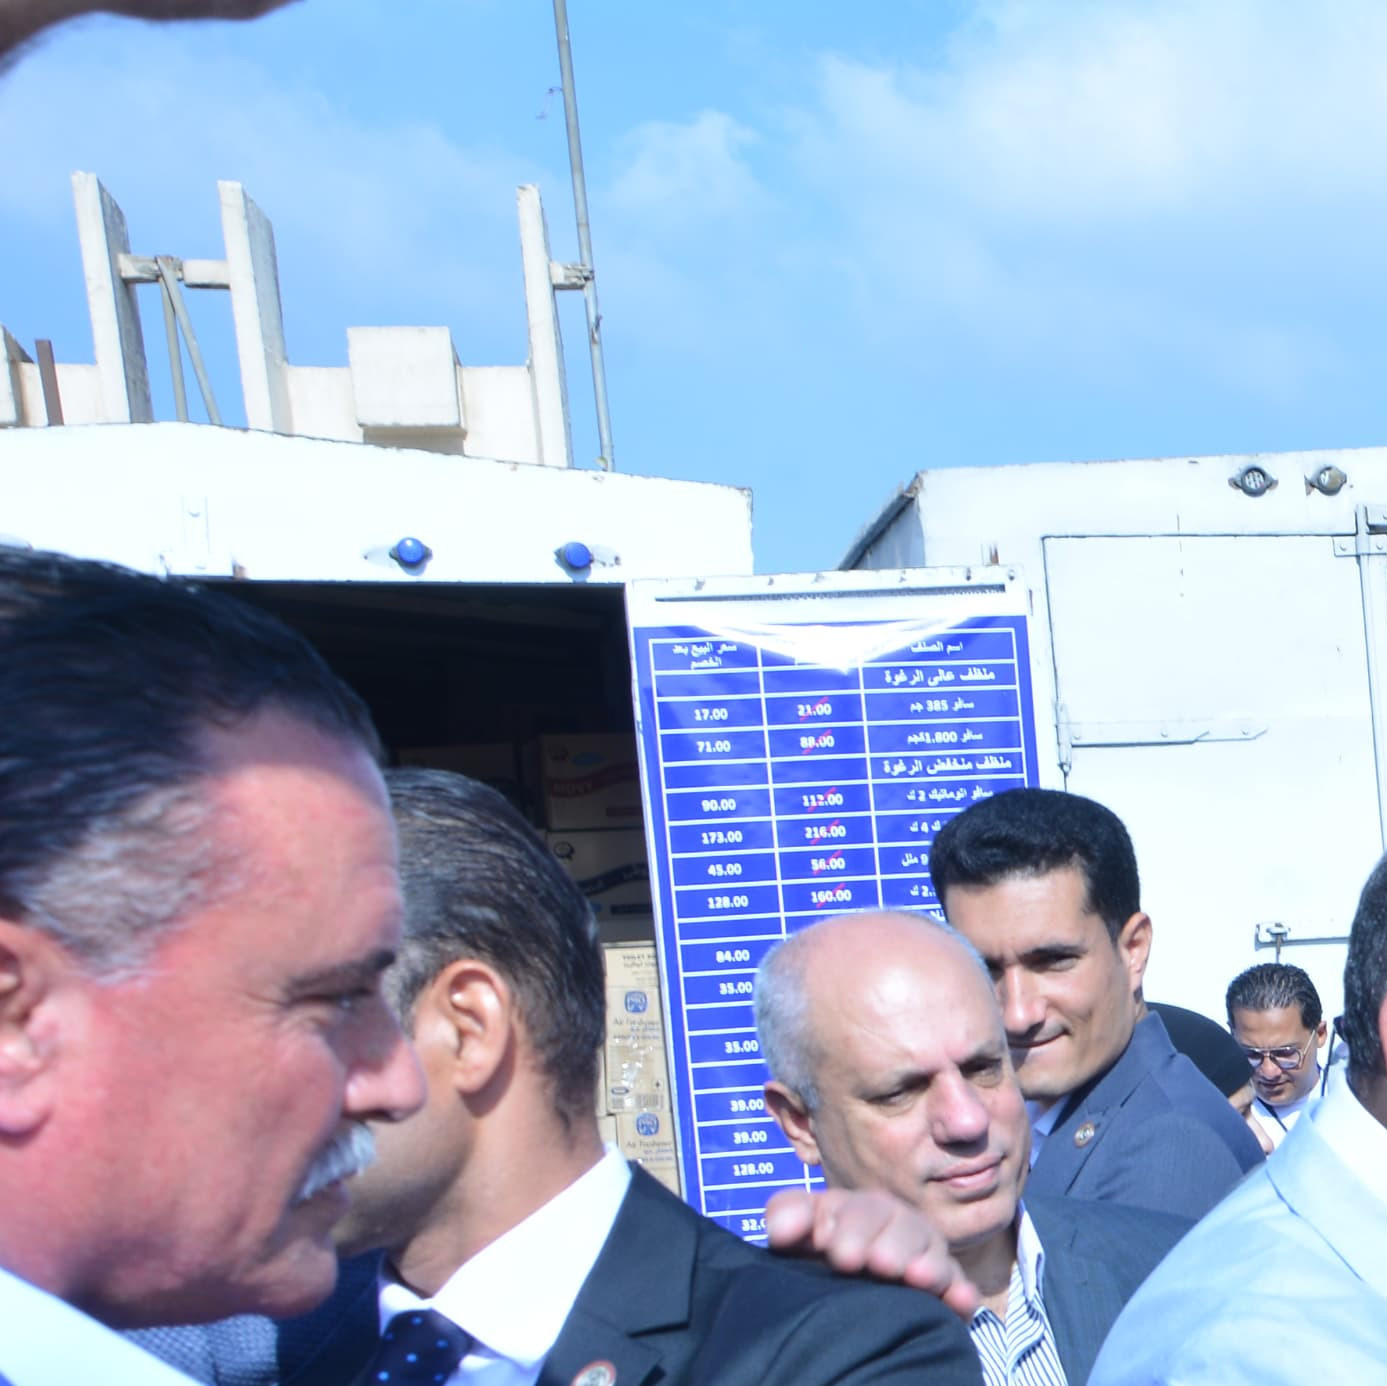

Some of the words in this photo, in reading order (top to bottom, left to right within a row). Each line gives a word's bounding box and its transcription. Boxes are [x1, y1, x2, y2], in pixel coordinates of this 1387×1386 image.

[694, 708, 728, 721] 17.00
[797, 702, 832, 717] 21.00
[696, 739, 731, 753] 71.00
[701, 798, 737, 812] 90.00
[701, 830, 743, 844] 173.00
[804, 825, 847, 839] 216.00
[707, 862, 743, 877] 45.00
[810, 857, 846, 871] 56.00
[811, 889, 852, 904] 160.00
